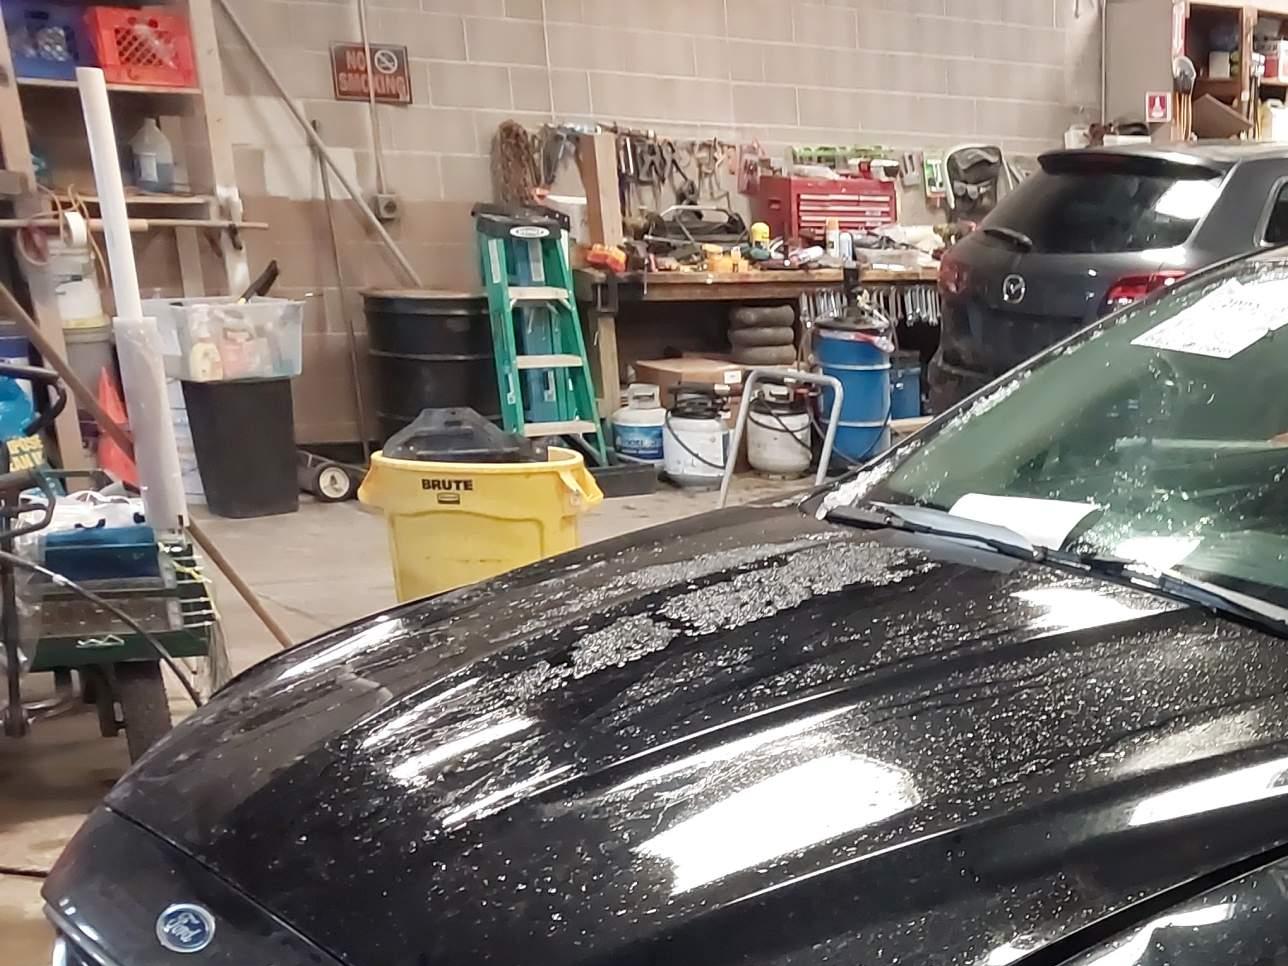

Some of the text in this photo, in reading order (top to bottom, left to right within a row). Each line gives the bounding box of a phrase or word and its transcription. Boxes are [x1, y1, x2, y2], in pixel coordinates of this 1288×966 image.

[346, 50, 366, 71] NO
[421, 478, 473, 491] BRUTE
[163, 912, 202, 943] Ford
